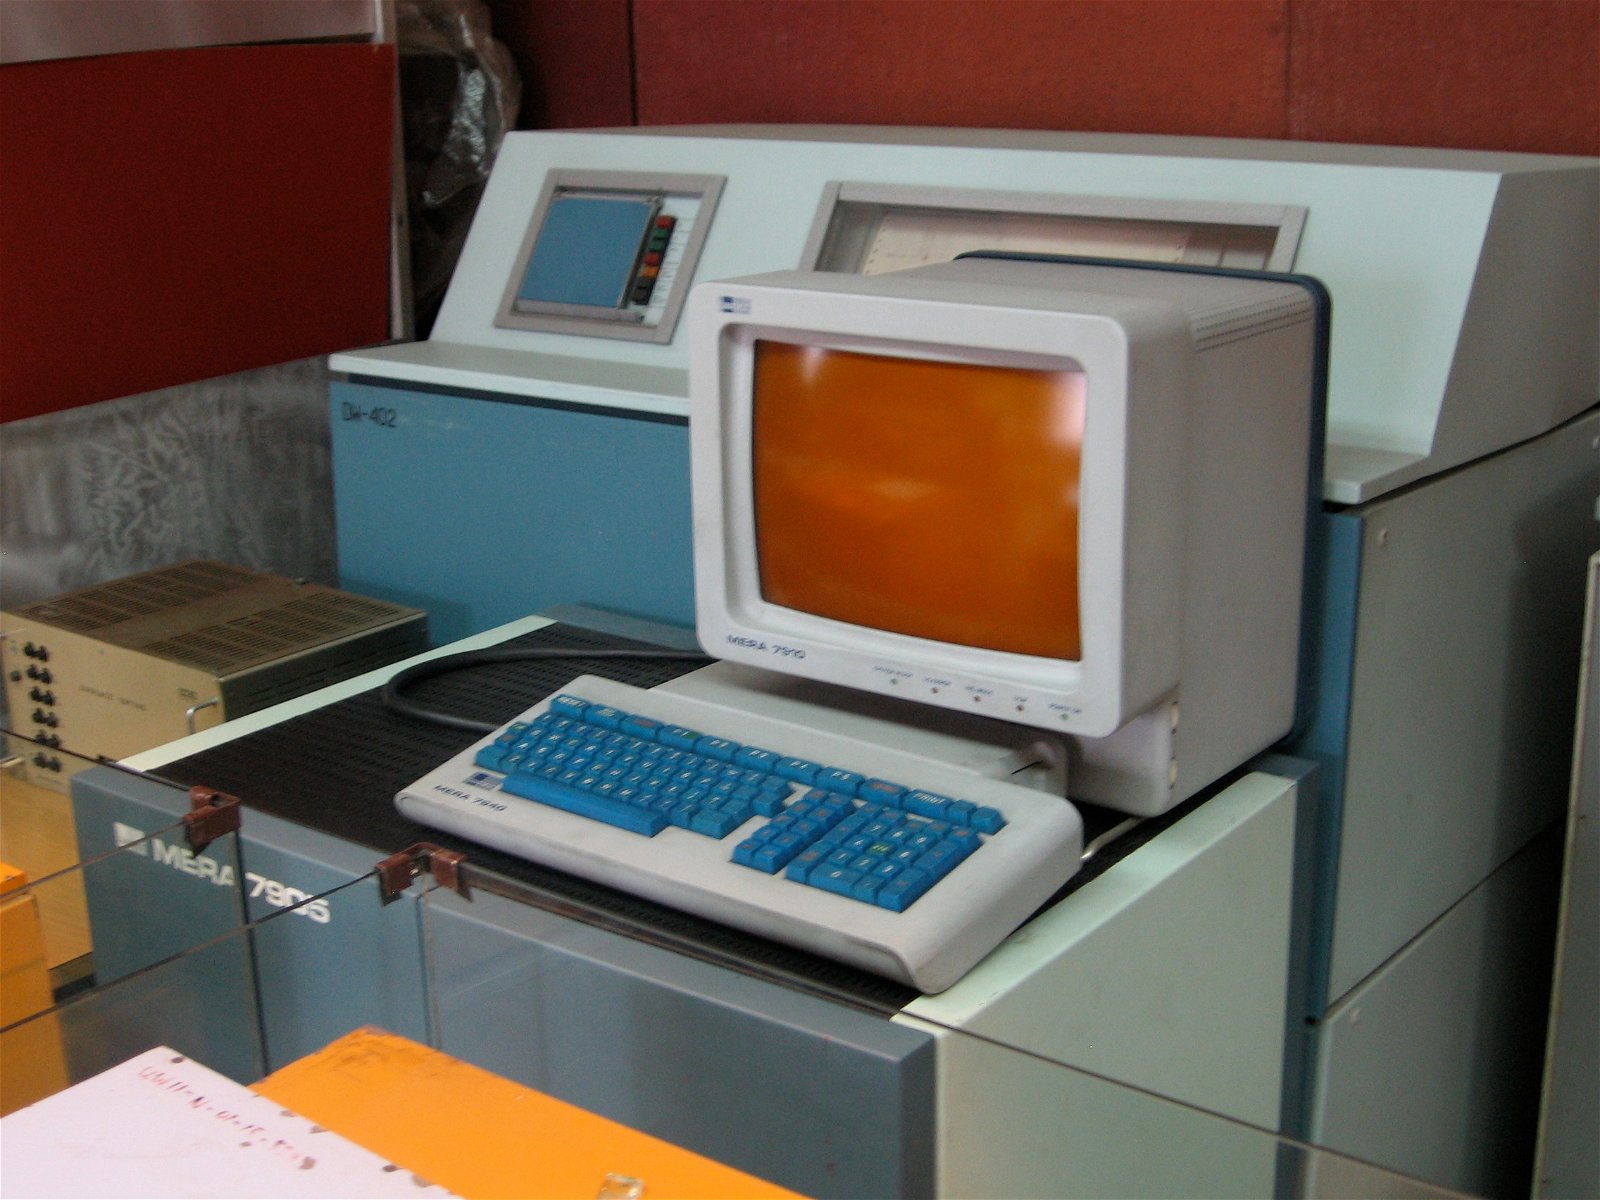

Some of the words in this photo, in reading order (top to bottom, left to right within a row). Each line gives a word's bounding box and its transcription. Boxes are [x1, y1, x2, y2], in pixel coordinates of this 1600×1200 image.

[727, 634, 768, 651] MERA
[433, 785, 471, 799] MERA
[151, 838, 236, 886] MERA
[245, 872, 331, 924] 7905
